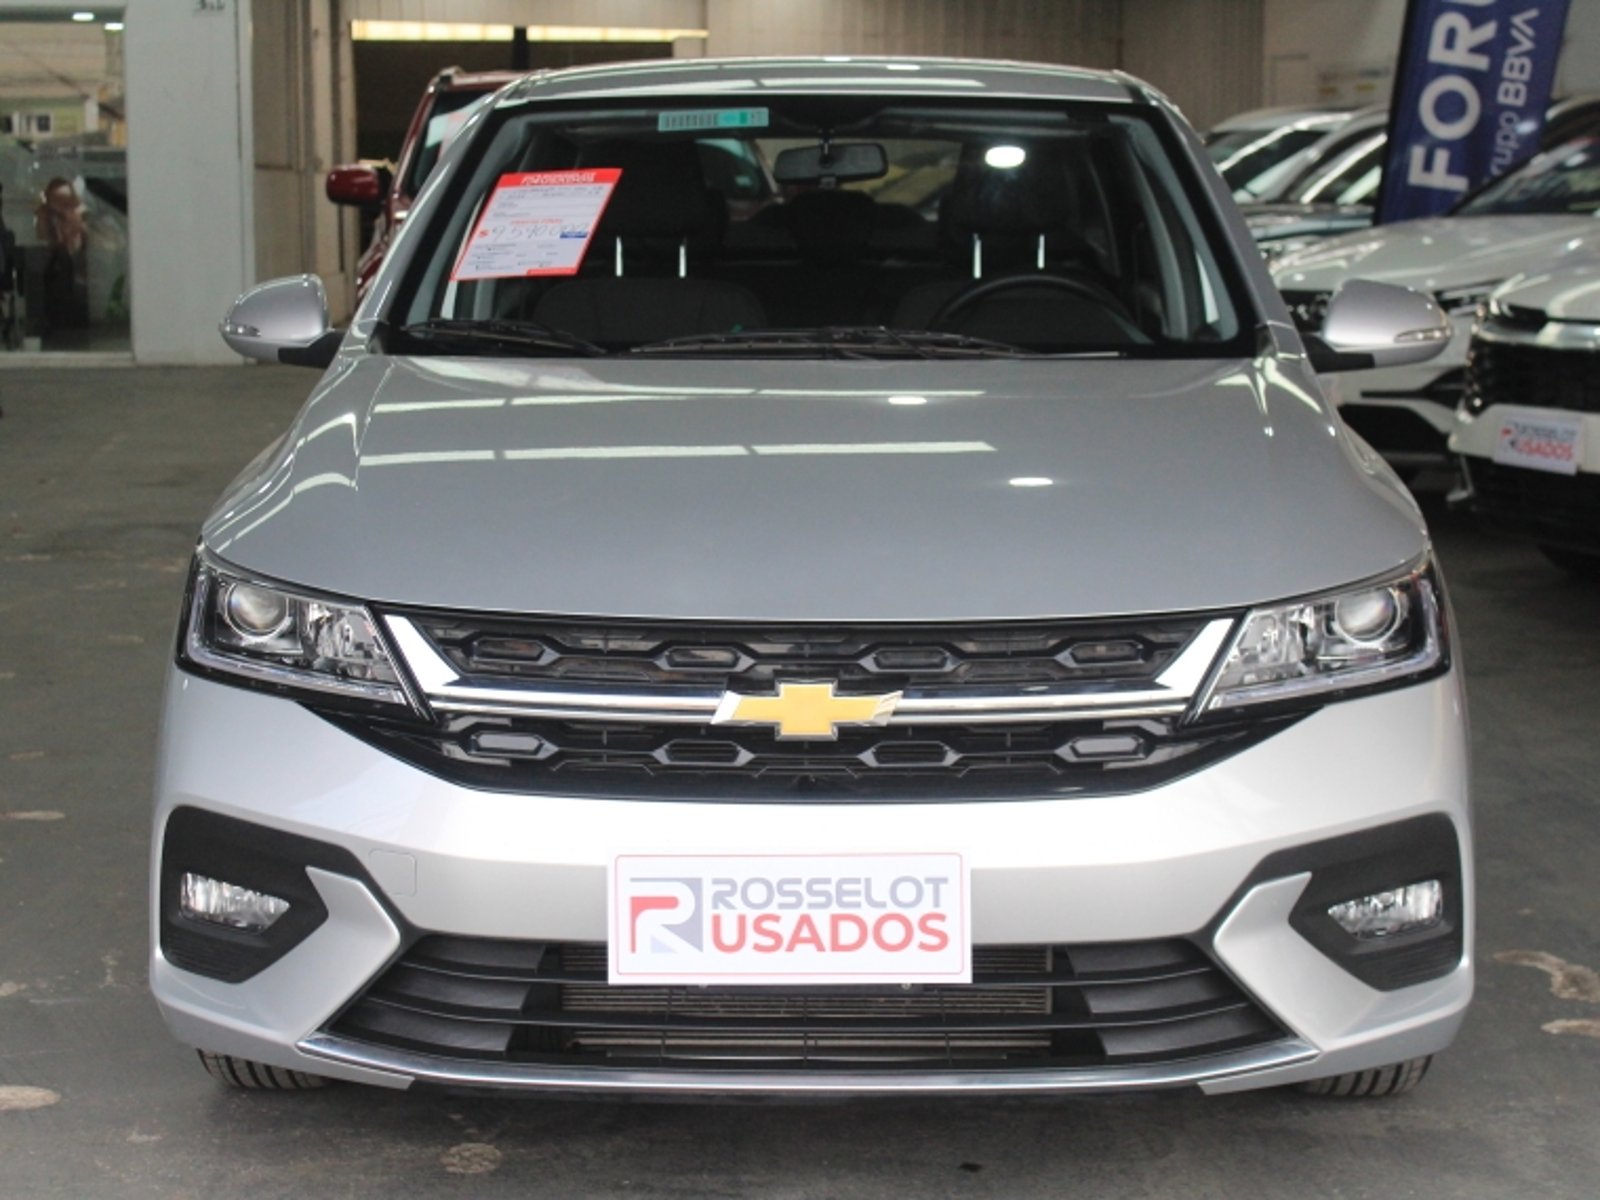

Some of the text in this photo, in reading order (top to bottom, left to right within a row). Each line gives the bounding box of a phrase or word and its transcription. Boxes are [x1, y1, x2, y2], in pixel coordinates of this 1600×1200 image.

[1407, 0, 1498, 192] FOR
[1483, 8, 1540, 183] rupo BBVA
[711, 876, 949, 910] ROSSELOT
[711, 912, 950, 954] USADOS
